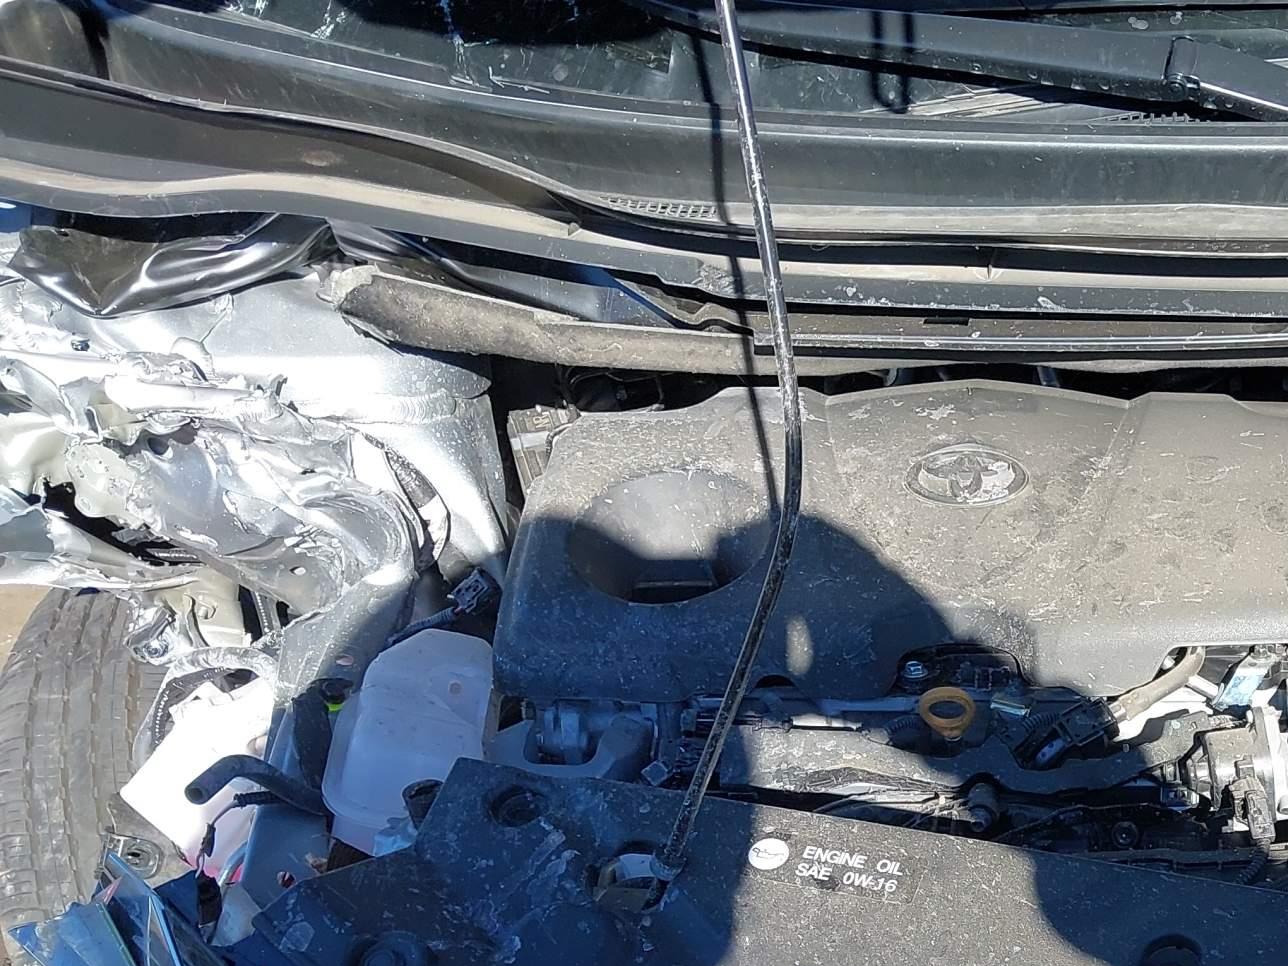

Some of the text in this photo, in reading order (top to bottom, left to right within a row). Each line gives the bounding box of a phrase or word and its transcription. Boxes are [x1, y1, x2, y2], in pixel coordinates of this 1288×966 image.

[802, 845, 904, 876] ENGINE OIL
[795, 862, 898, 893] SAE 0W-16
